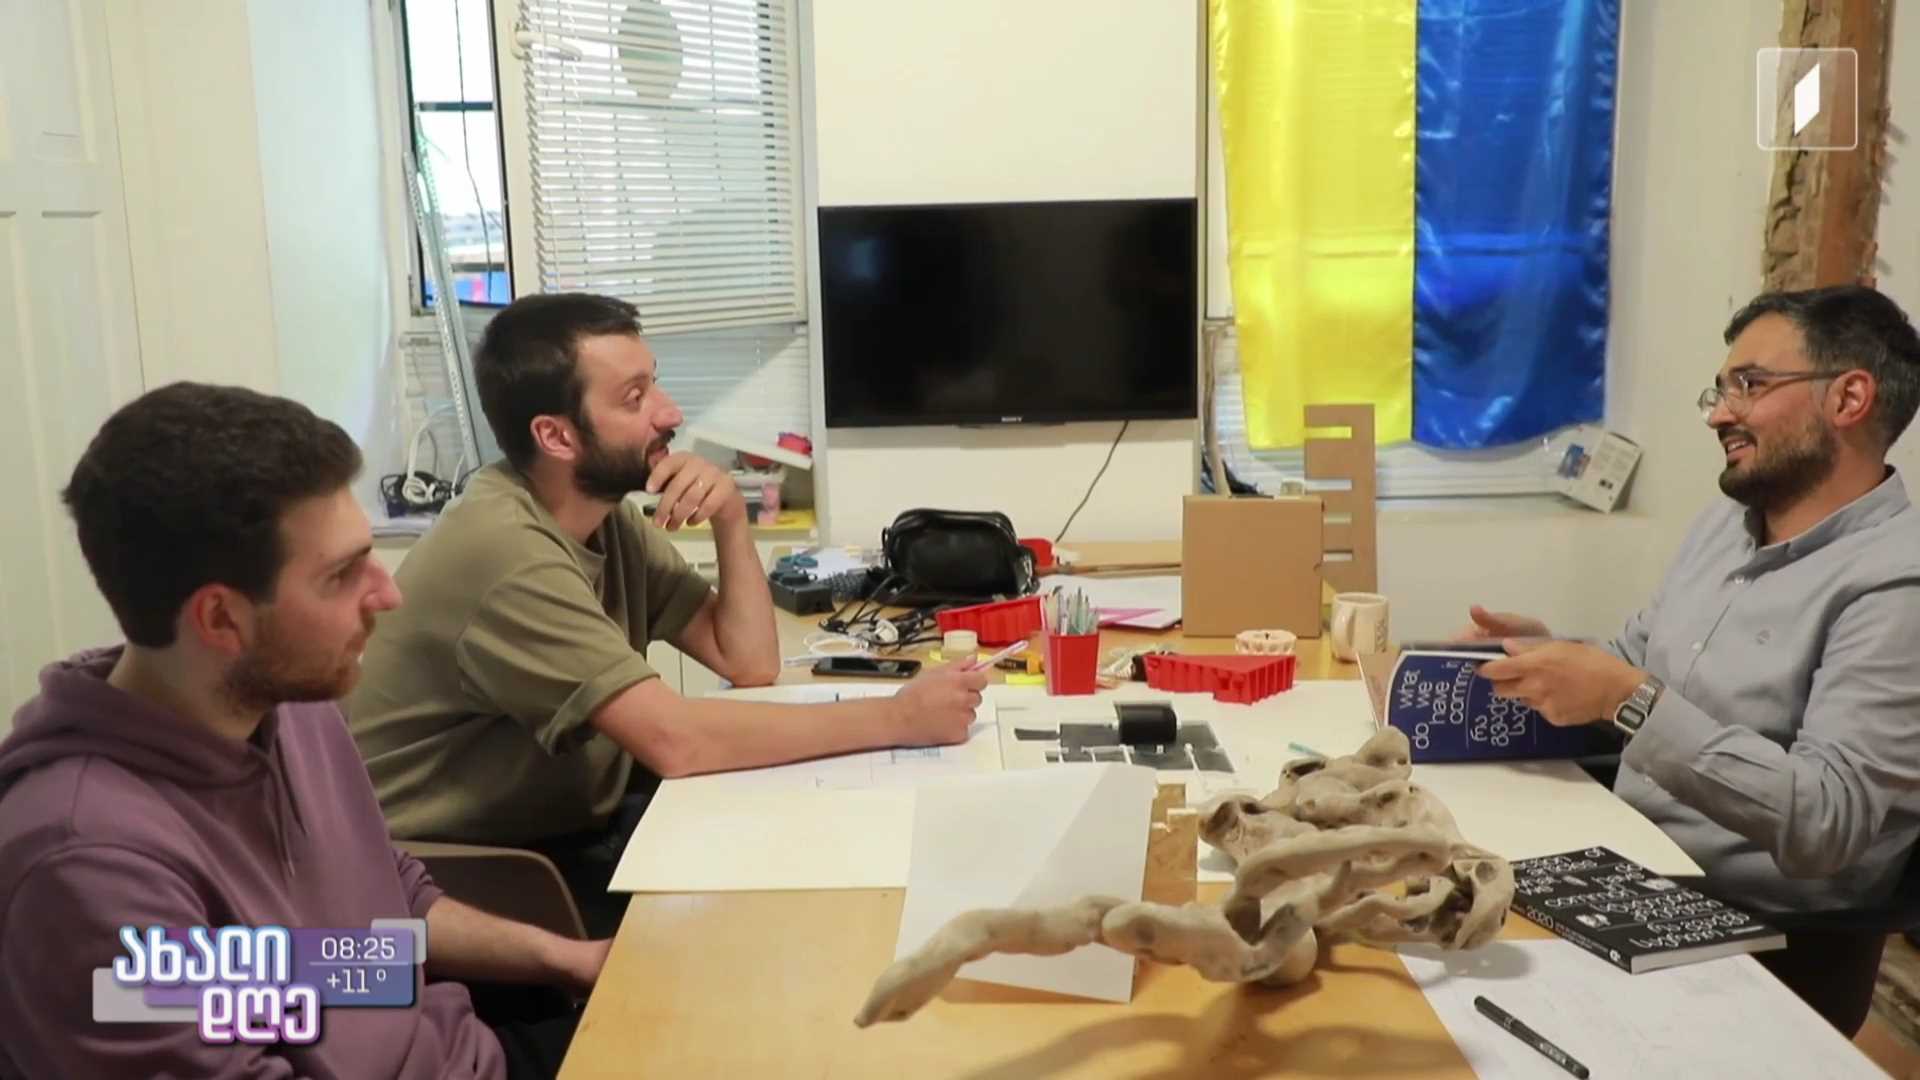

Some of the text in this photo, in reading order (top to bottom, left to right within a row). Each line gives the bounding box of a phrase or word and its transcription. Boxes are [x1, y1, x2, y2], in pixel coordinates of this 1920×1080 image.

[1411, 681, 1433, 749] do we
[1428, 681, 1450, 725] have
